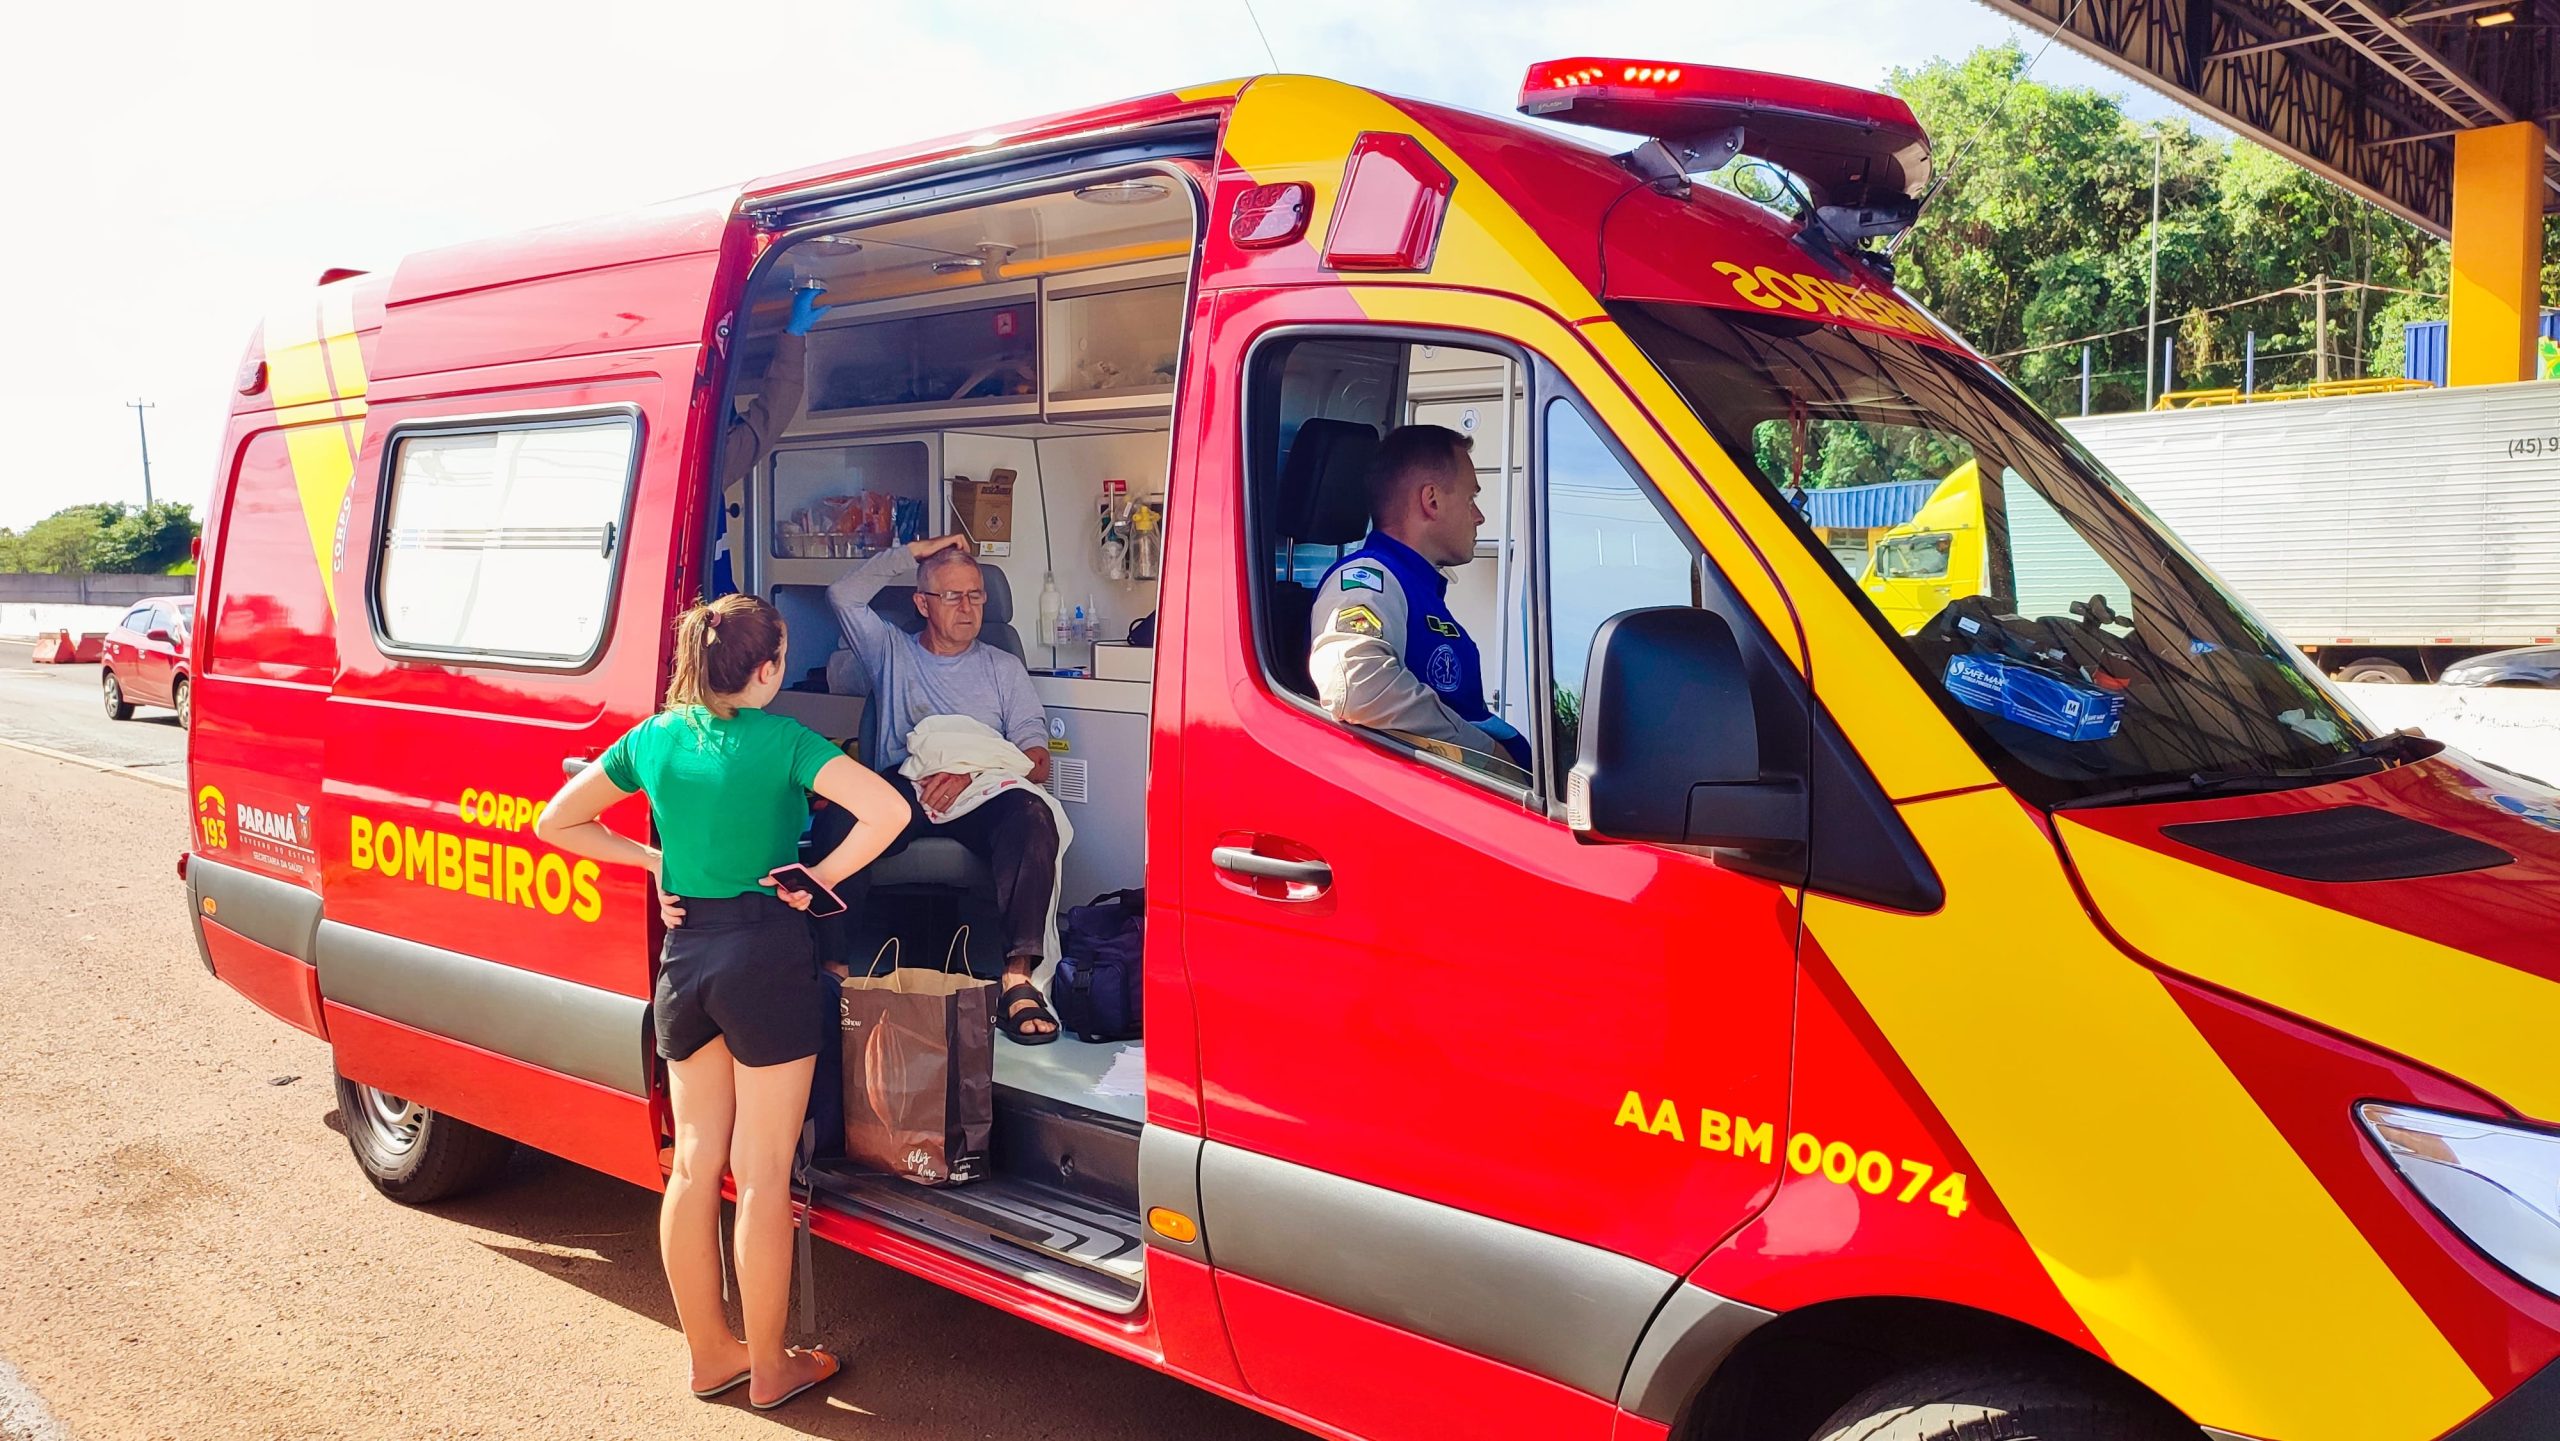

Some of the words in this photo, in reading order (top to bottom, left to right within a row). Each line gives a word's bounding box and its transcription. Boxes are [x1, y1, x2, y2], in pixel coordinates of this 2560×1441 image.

[2508, 437, 2543, 459] (45)
[2548, 436, 2559, 452] 9
[333, 495, 351, 573] CORPO
[1962, 667, 1985, 680] SAFE
[2067, 703, 2077, 713] M
[201, 816, 228, 850] 193
[237, 803, 298, 844] PARANÁ
[350, 815, 602, 923] BOMBEIROS
[1614, 1090, 1685, 1142] AA
[1700, 1108, 1774, 1164] BM
[1787, 1132, 1968, 1218] 00074
